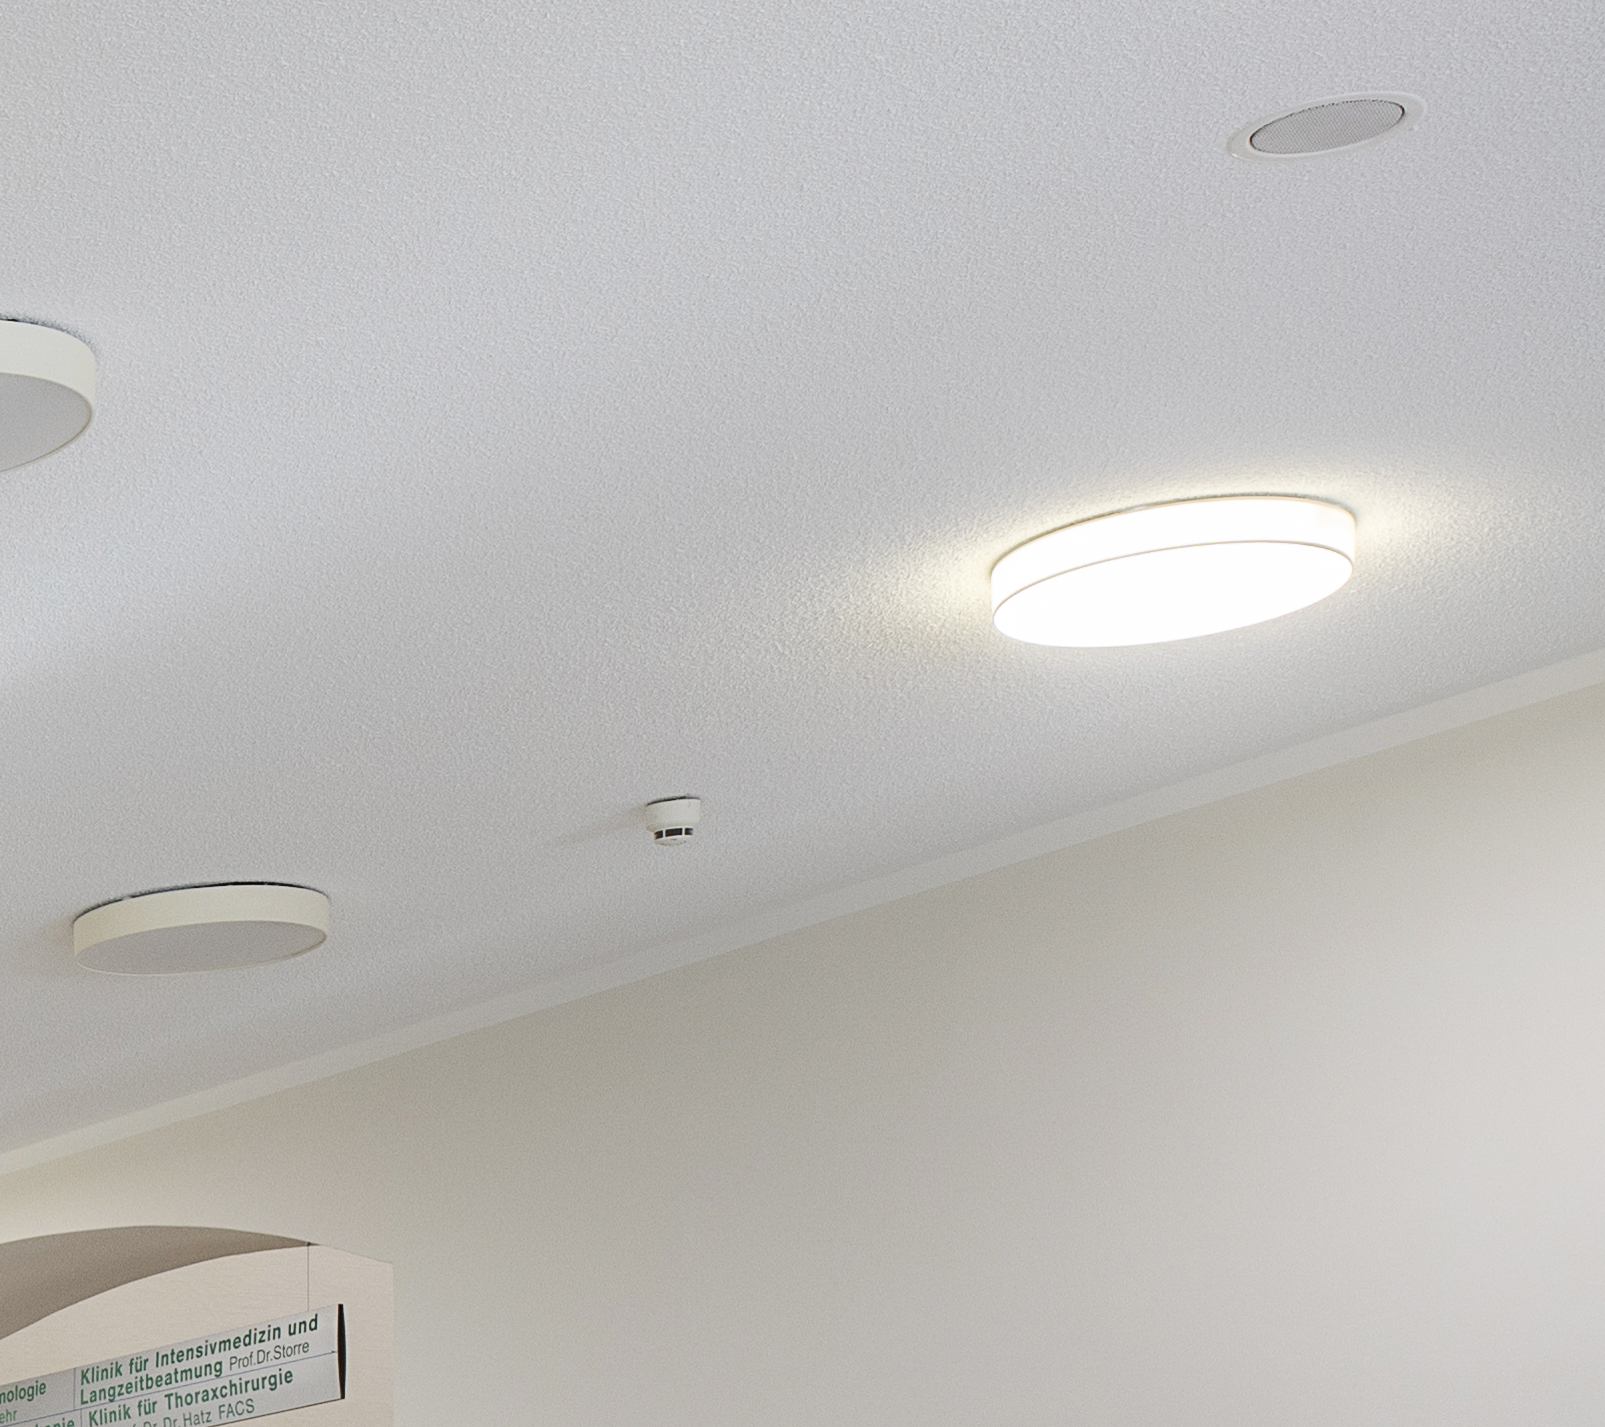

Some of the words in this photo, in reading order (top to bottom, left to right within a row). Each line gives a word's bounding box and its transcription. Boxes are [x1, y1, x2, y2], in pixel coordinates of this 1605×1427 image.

[80, 1364, 124, 1385] Klinik
[128, 1356, 149, 1376] für
[155, 1325, 282, 1368] Intensivmedizin
[288, 1315, 319, 1337] und
[80, 1360, 224, 1405] Langzeitbeatmung
[88, 1405, 132, 1427] Klinik
[136, 1397, 158, 1417] für
[163, 1368, 294, 1412] Thoraxchirurgie
[217, 1399, 255, 1420] FACS
